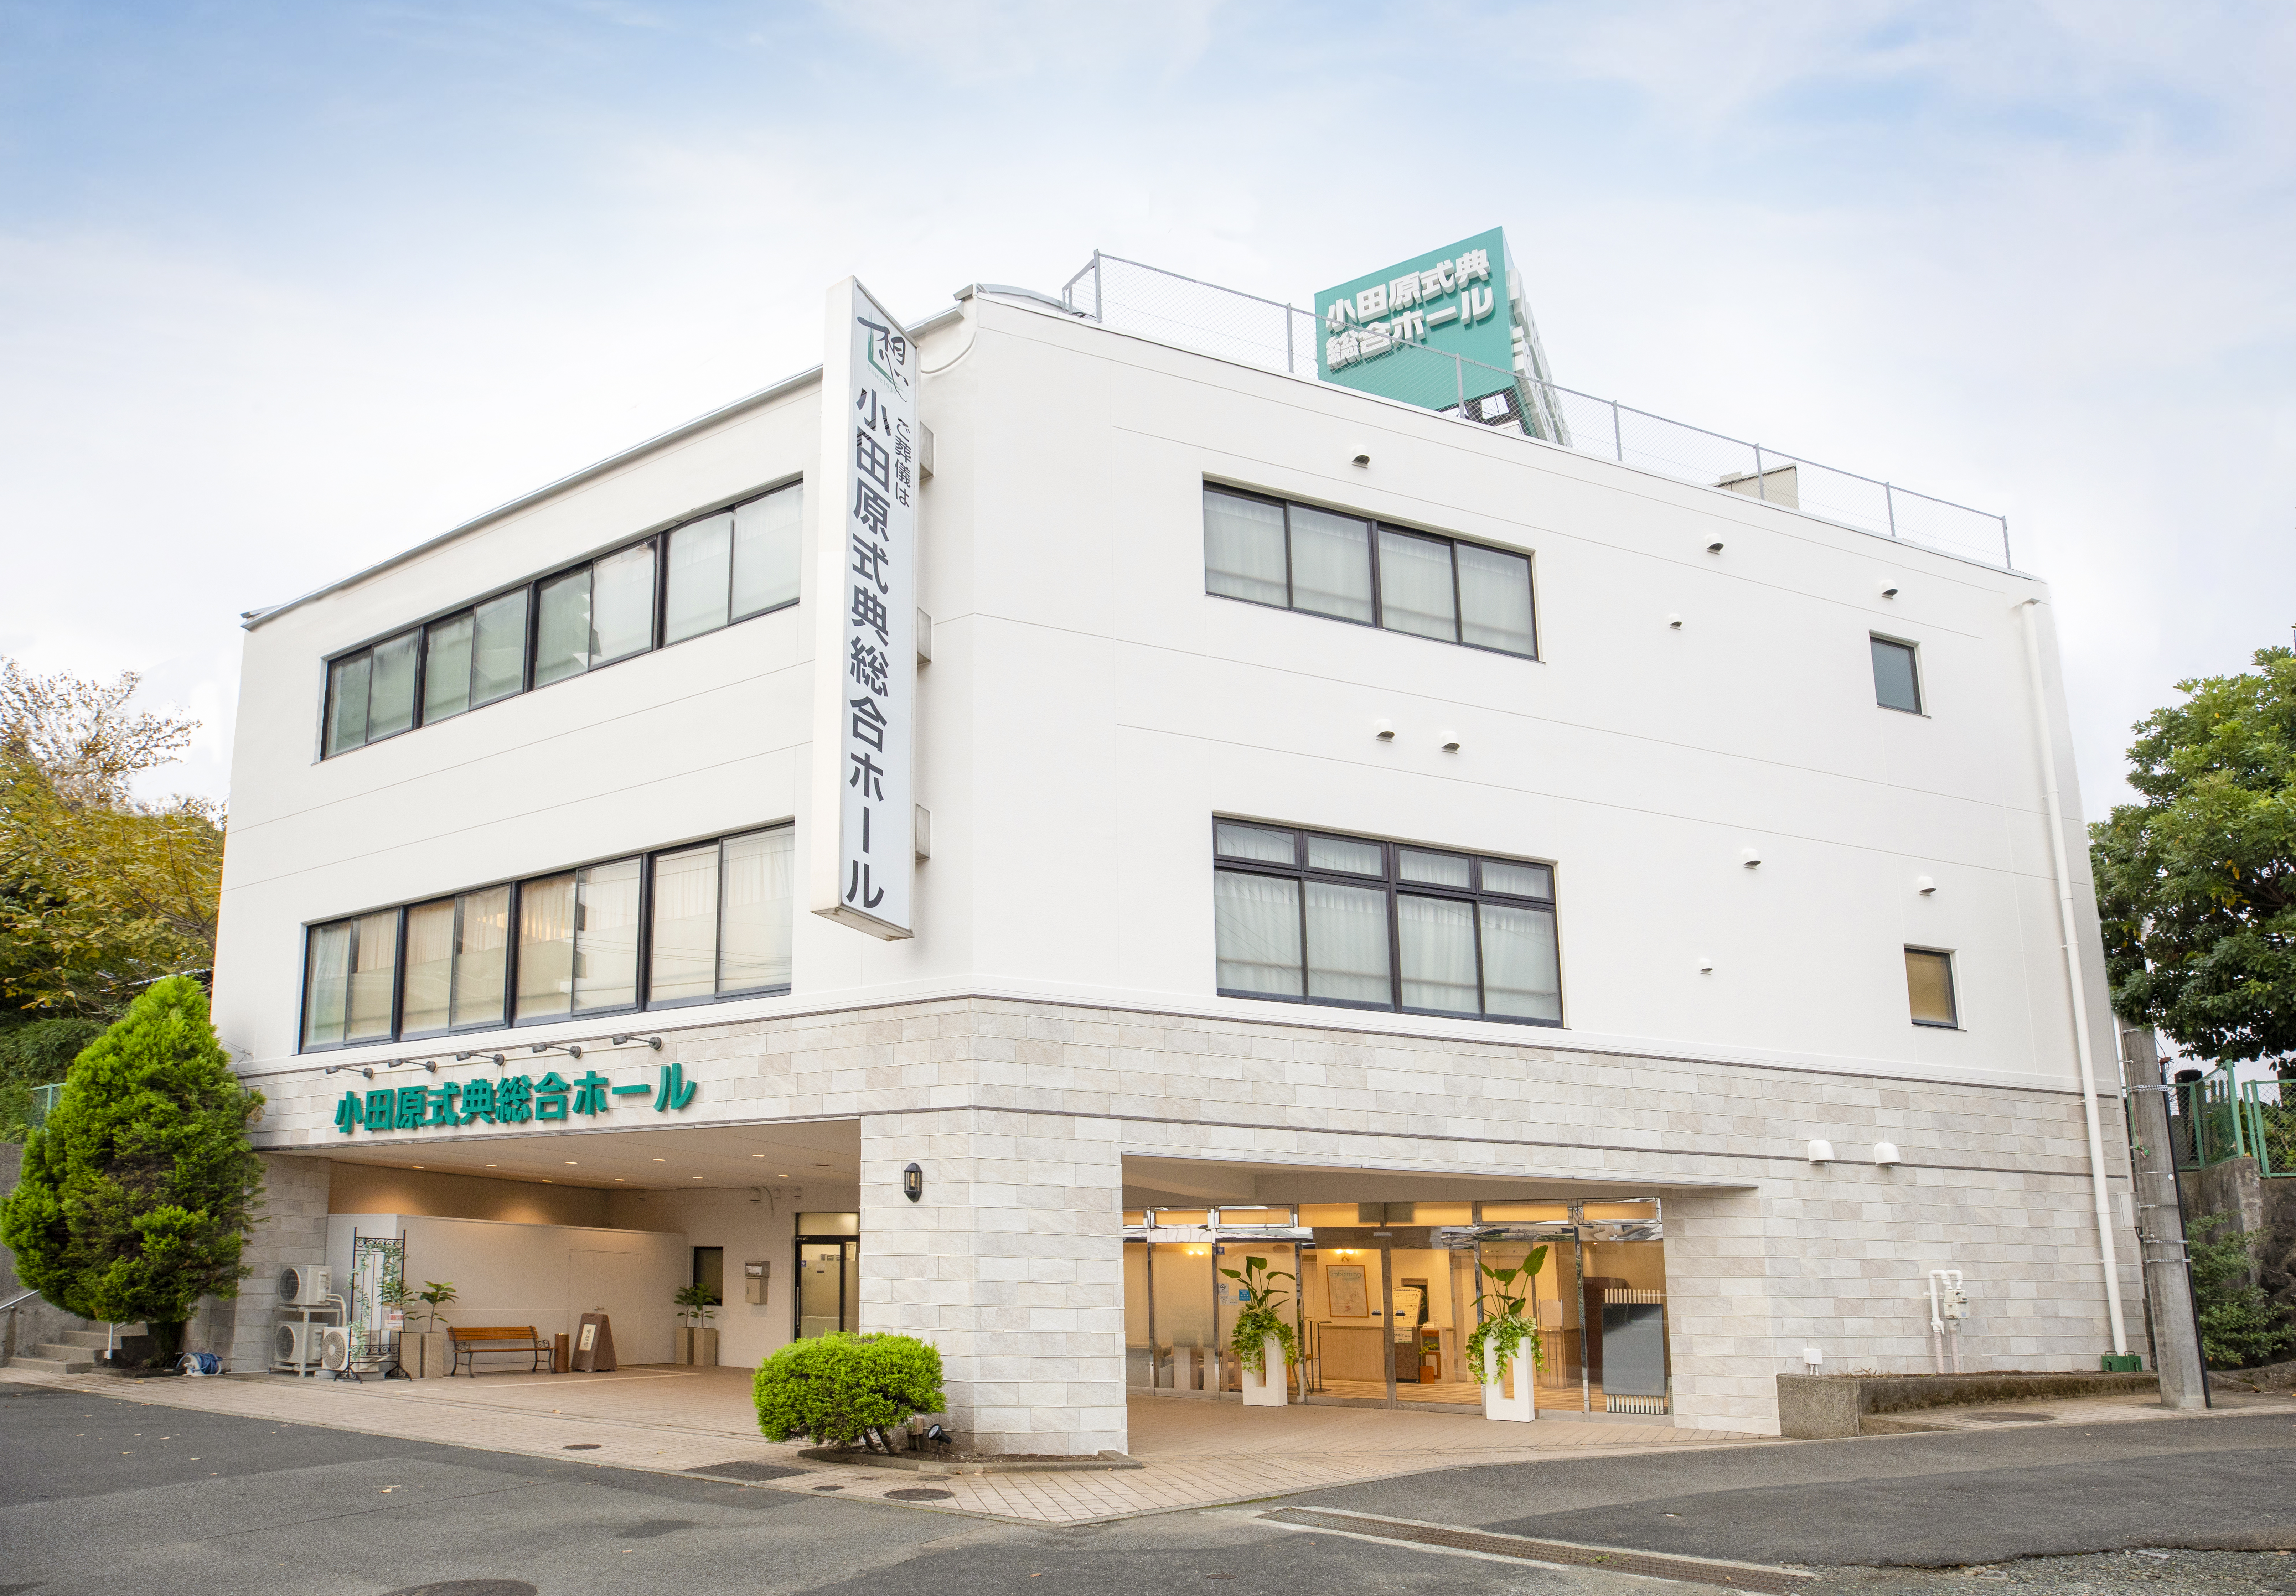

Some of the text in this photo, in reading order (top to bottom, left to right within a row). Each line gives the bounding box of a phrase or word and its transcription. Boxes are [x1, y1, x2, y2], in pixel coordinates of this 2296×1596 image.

[1325, 249, 1491, 333] 小田原式典
[1325, 287, 1494, 370] 総合ホール
[895, 416, 911, 508] ご葬儀は
[846, 388, 891, 909] 小田原式典総合ホール
[334, 1063, 697, 1133] 小田原式典総合ホール
